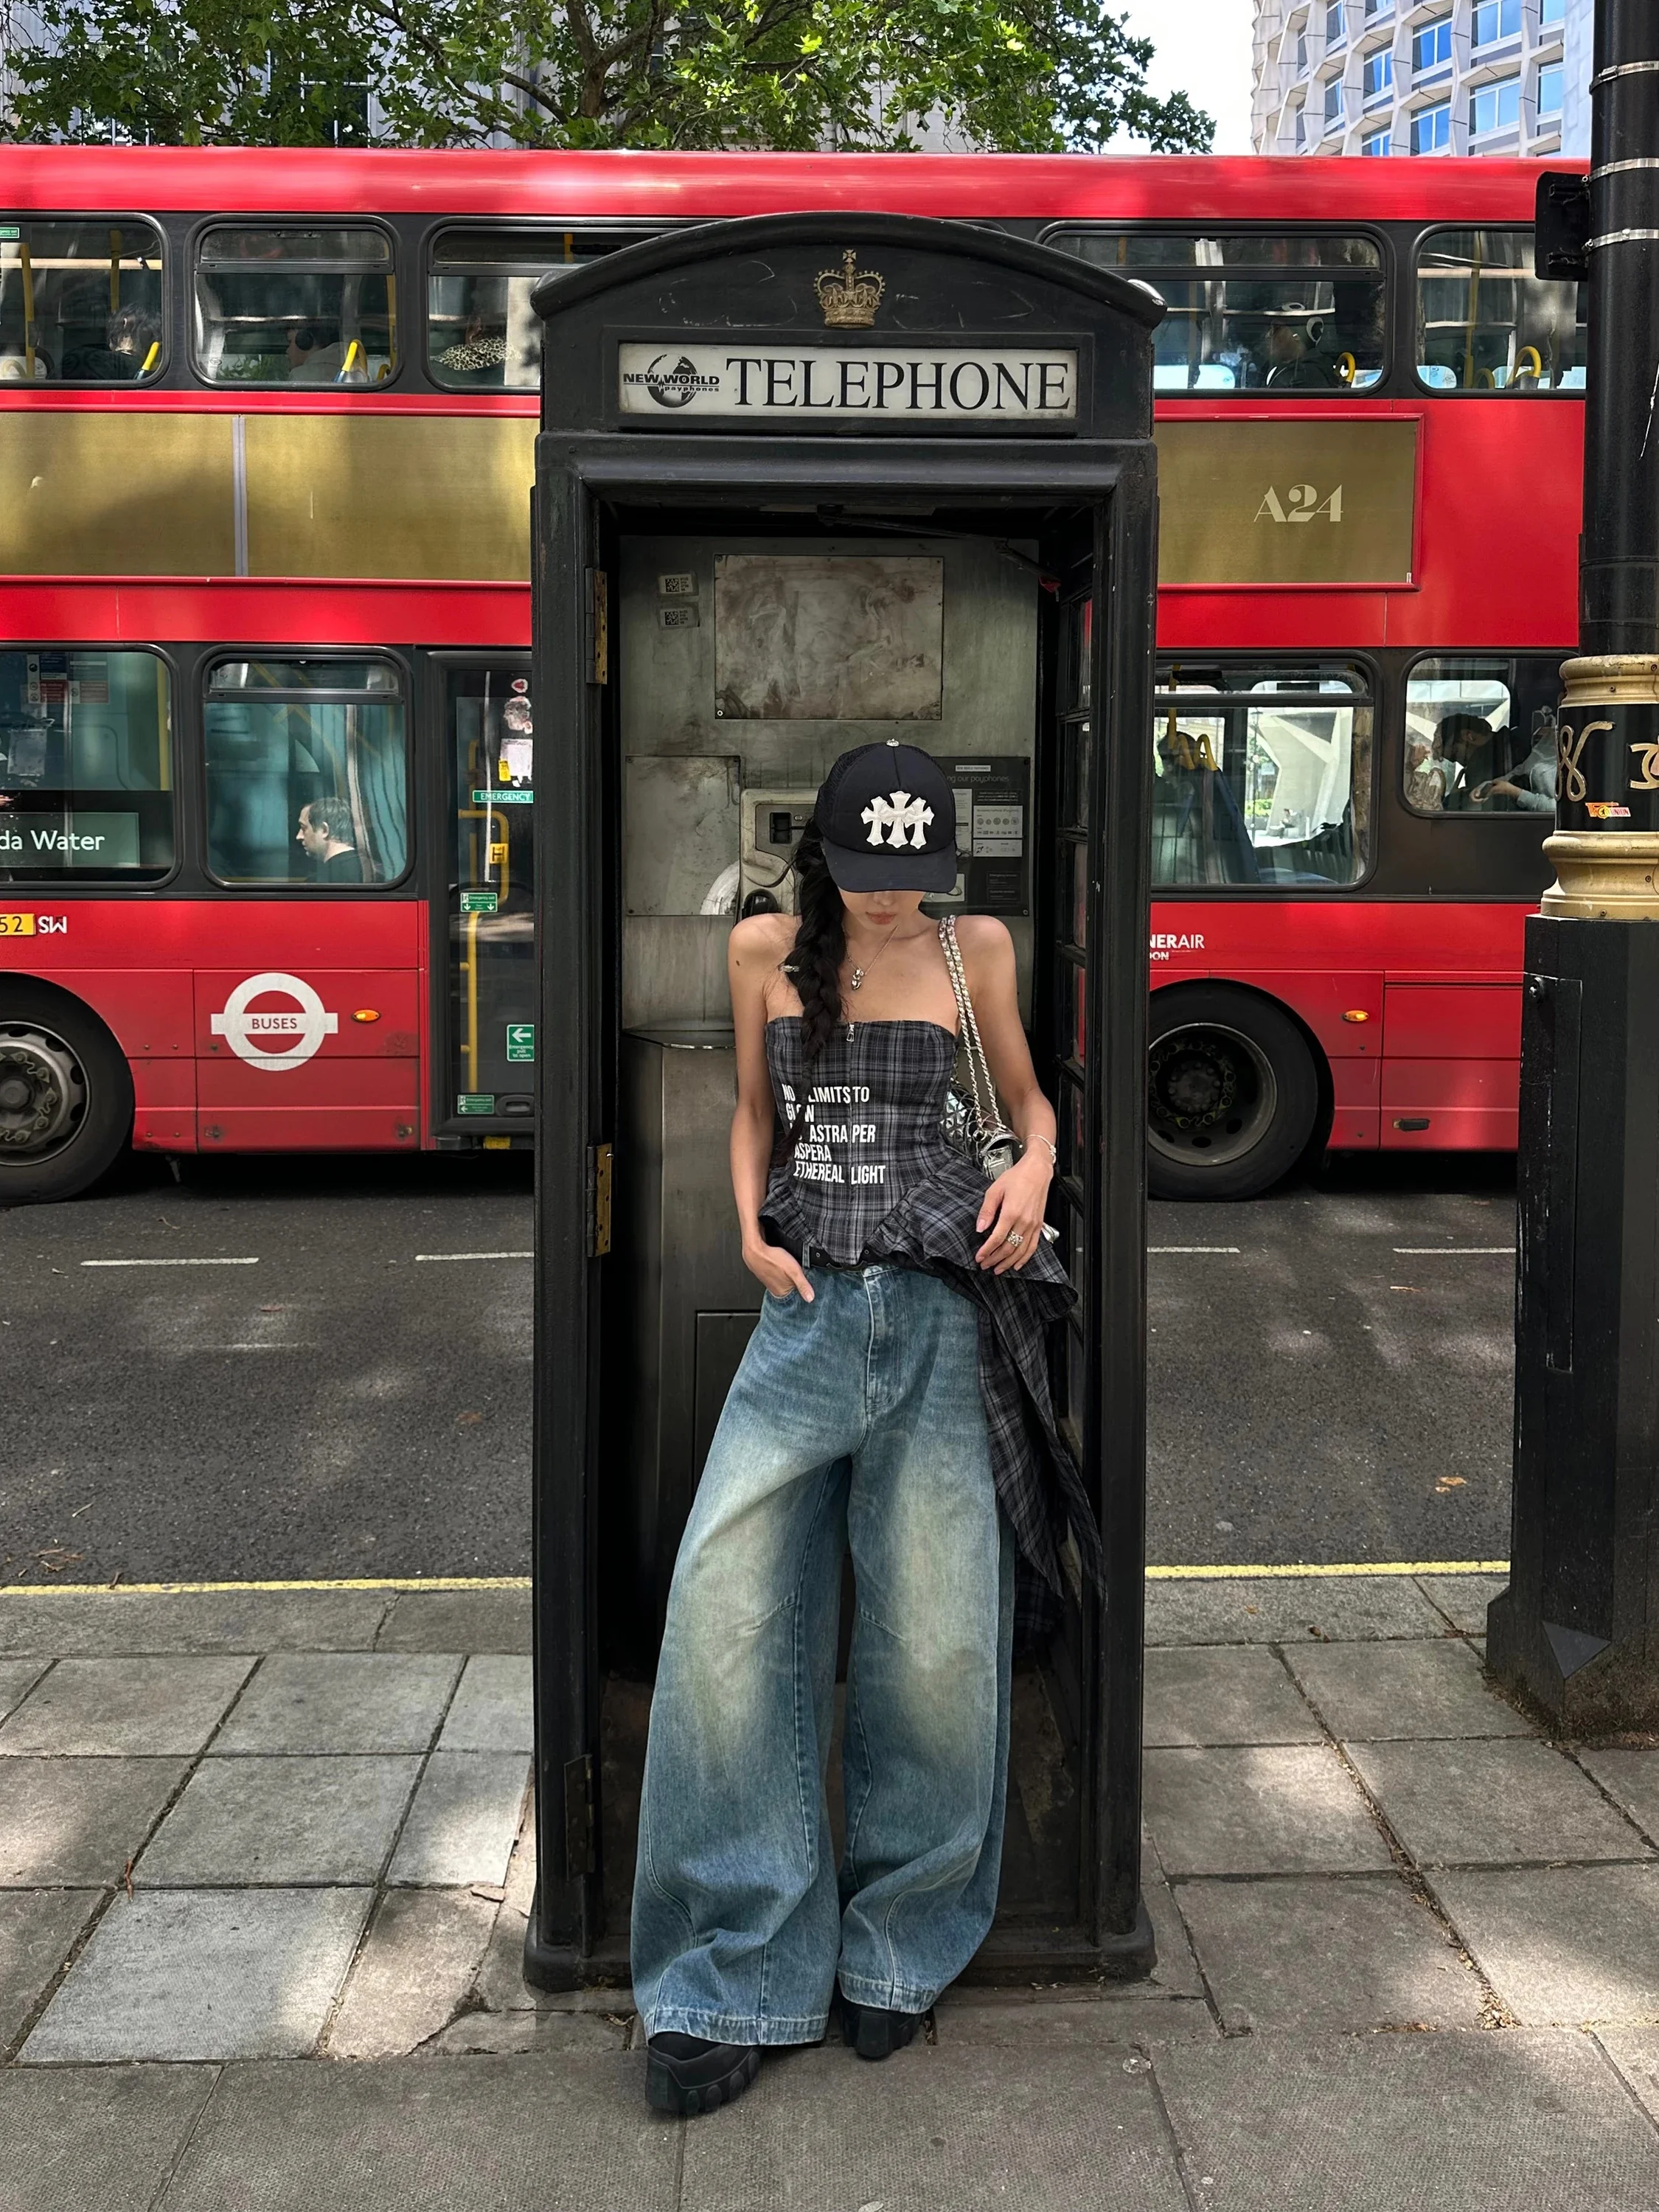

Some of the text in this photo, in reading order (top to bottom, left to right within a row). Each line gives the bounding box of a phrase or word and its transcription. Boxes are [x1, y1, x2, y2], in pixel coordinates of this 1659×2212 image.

[623, 373, 720, 385] NEW WORLD
[726, 358, 1071, 410] TELEPHONE
[1253, 484, 1344, 523] A24
[970, 775, 1010, 784] payphones
[480, 793, 531, 801] EMERGENCY
[0, 830, 105, 851] da Water
[38, 916, 68, 934] SW
[251, 1018, 297, 1029] BUSES
[782, 1083, 796, 1102] NO
[852, 1086, 870, 1103] TO
[809, 1124, 848, 1143] ASTRA
[852, 1124, 877, 1143] PER
[793, 1142, 832, 1161] ASPERA
[793, 1161, 886, 1185] ETHEREAL LIGHT
